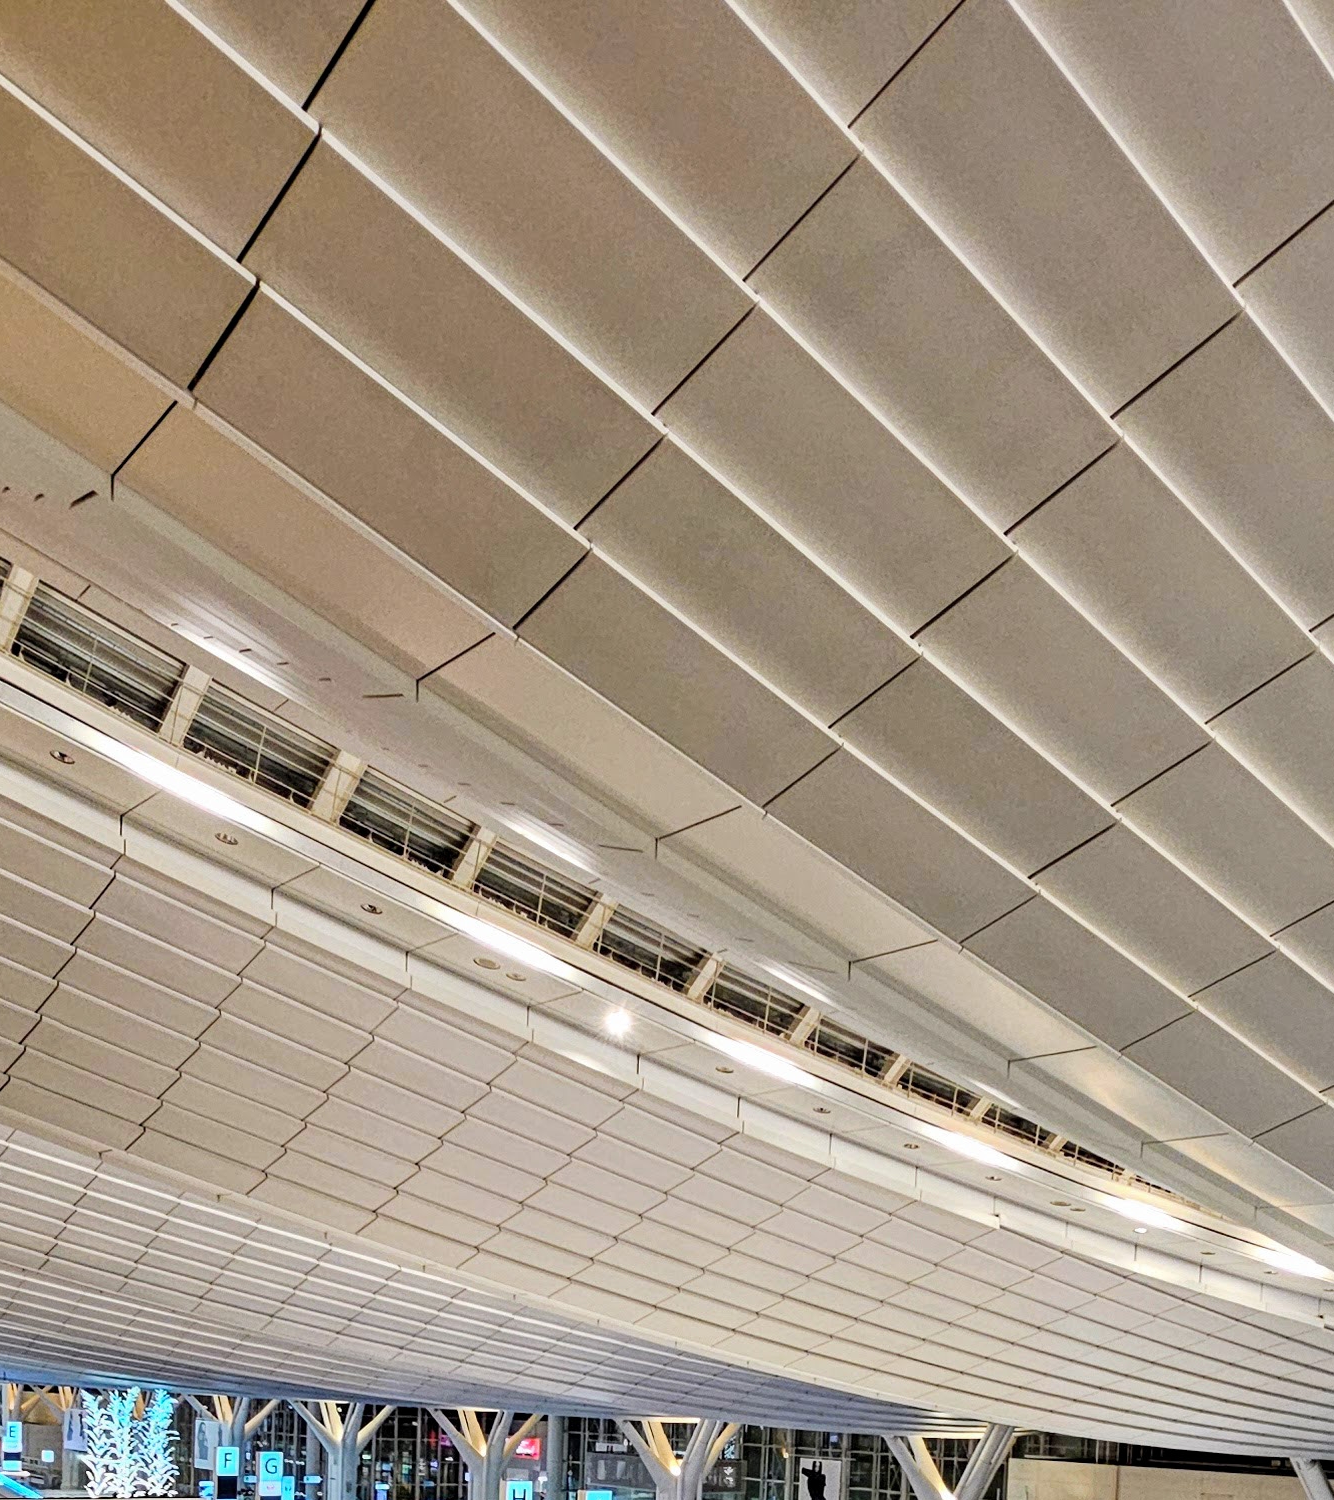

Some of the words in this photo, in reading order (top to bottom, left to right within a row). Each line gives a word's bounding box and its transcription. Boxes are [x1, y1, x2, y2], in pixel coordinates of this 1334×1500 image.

[9, 1425, 16, 1438] E
[224, 1452, 233, 1468] F
[265, 1457, 278, 1474] G
